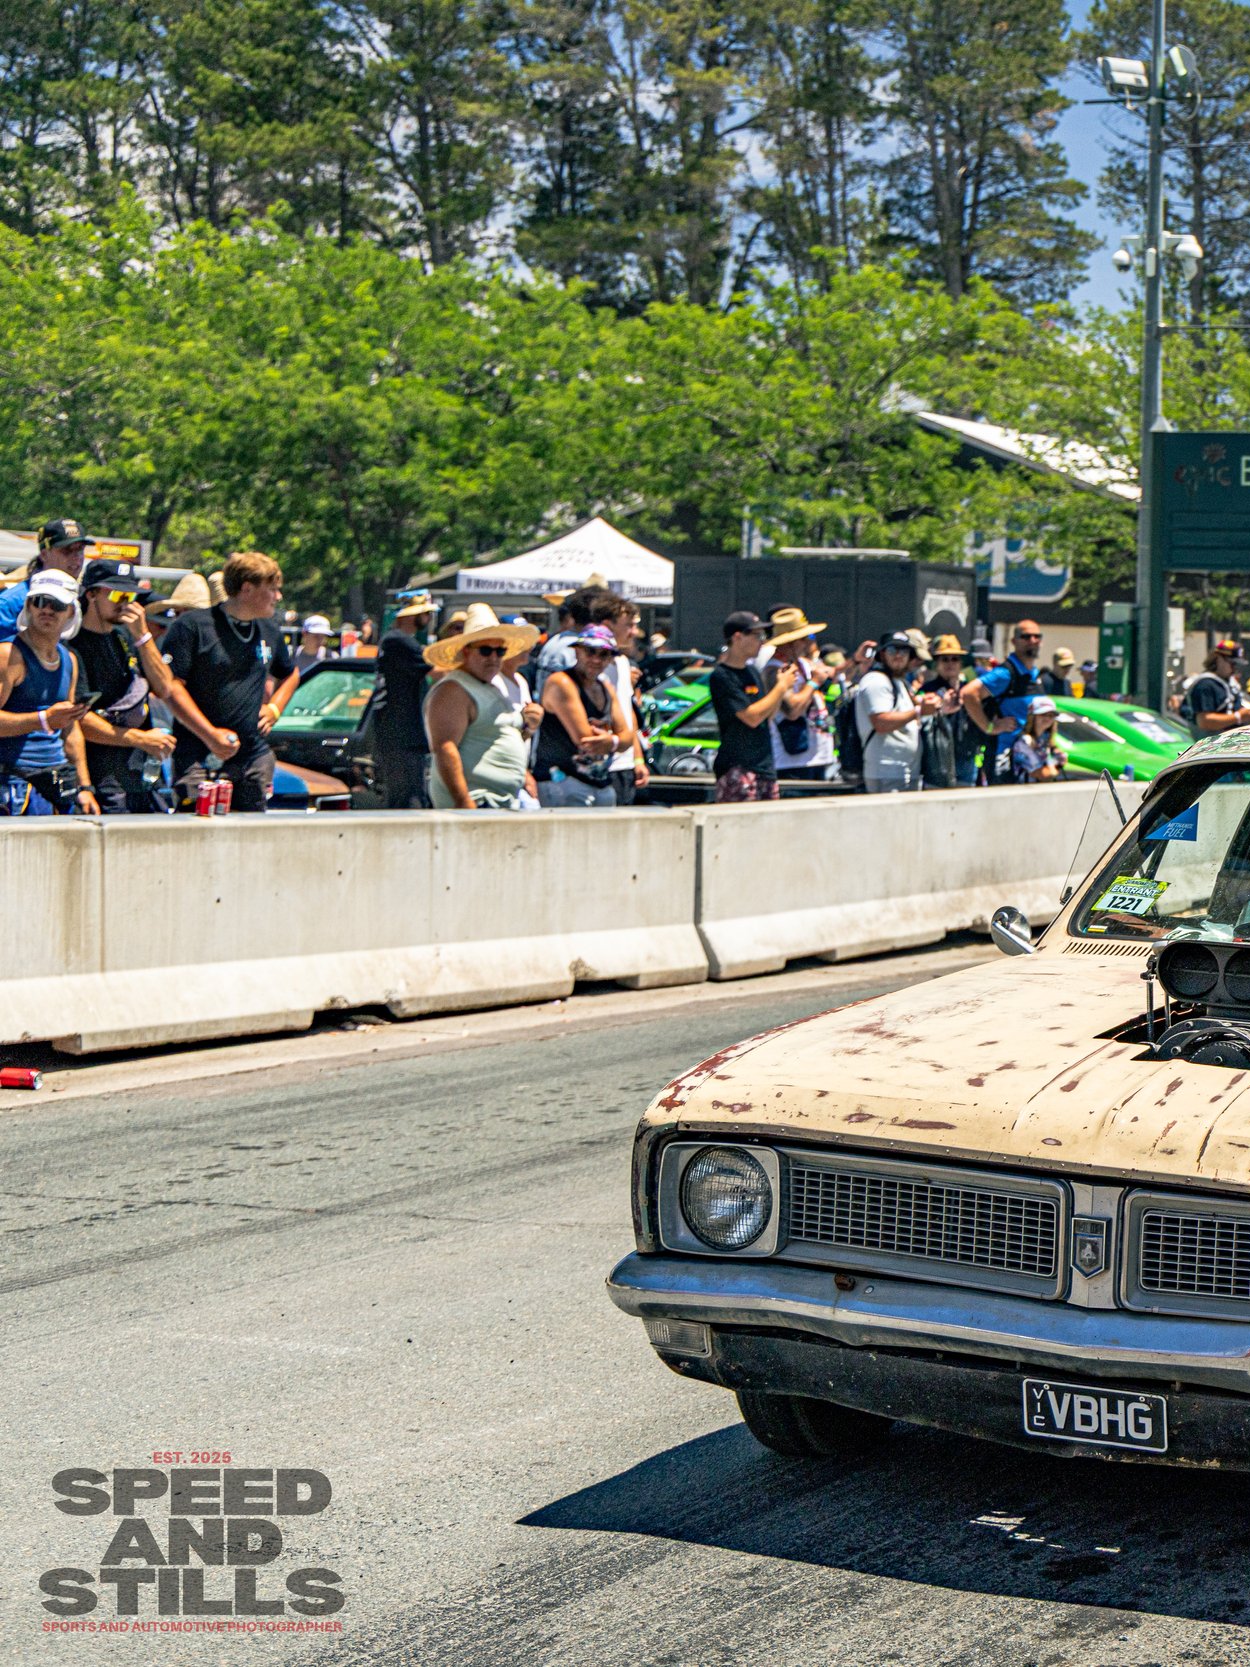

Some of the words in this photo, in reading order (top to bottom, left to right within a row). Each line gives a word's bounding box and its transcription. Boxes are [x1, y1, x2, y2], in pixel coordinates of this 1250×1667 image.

[1162, 827, 1186, 838] FUEL
[1111, 885, 1158, 898] ENTRANT
[1107, 895, 1143, 911] 1221
[1032, 1388, 1046, 1427] VIC
[1047, 1391, 1153, 1440] VBHG
